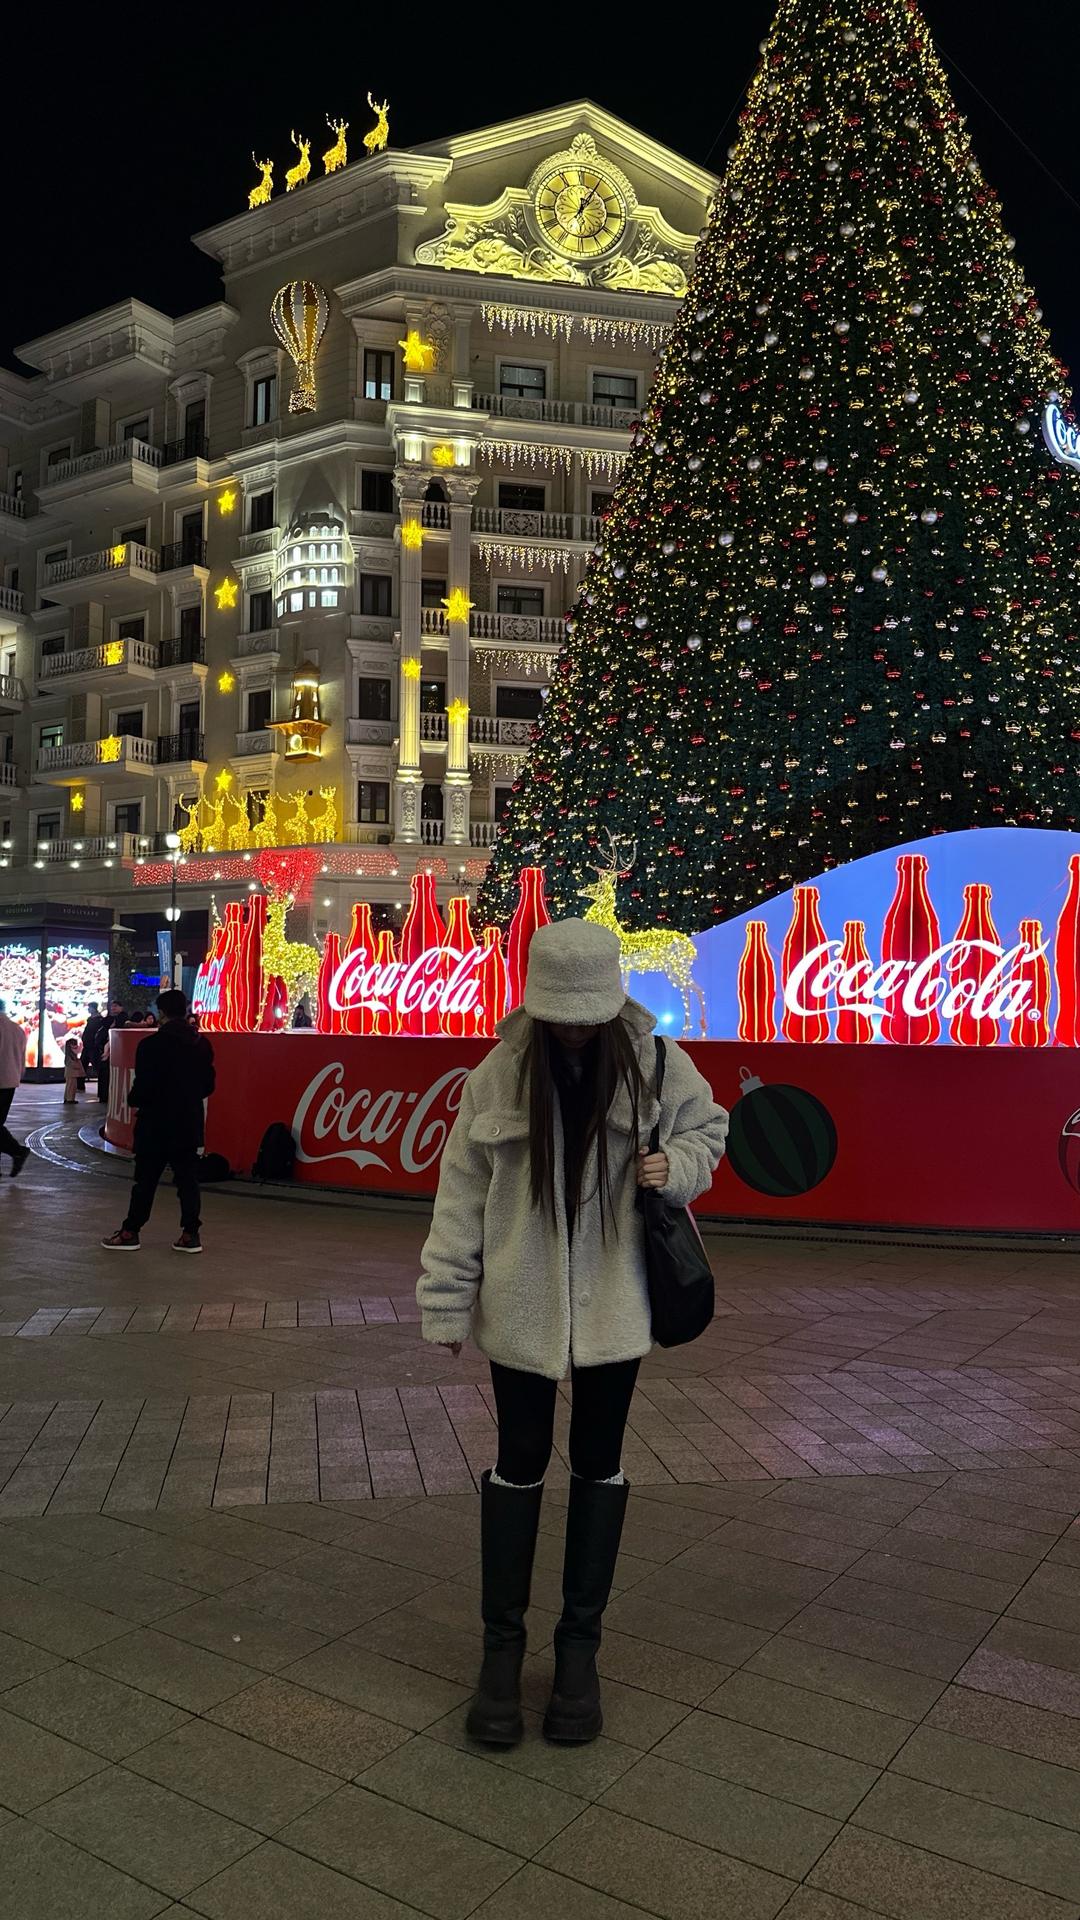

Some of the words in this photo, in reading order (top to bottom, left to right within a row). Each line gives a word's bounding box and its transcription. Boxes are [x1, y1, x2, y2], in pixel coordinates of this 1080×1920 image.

[328, 942, 496, 1015] Coca-Cola
[783, 938, 1050, 1020] Coca-Cola
[291, 1062, 474, 1174] Coca-C
